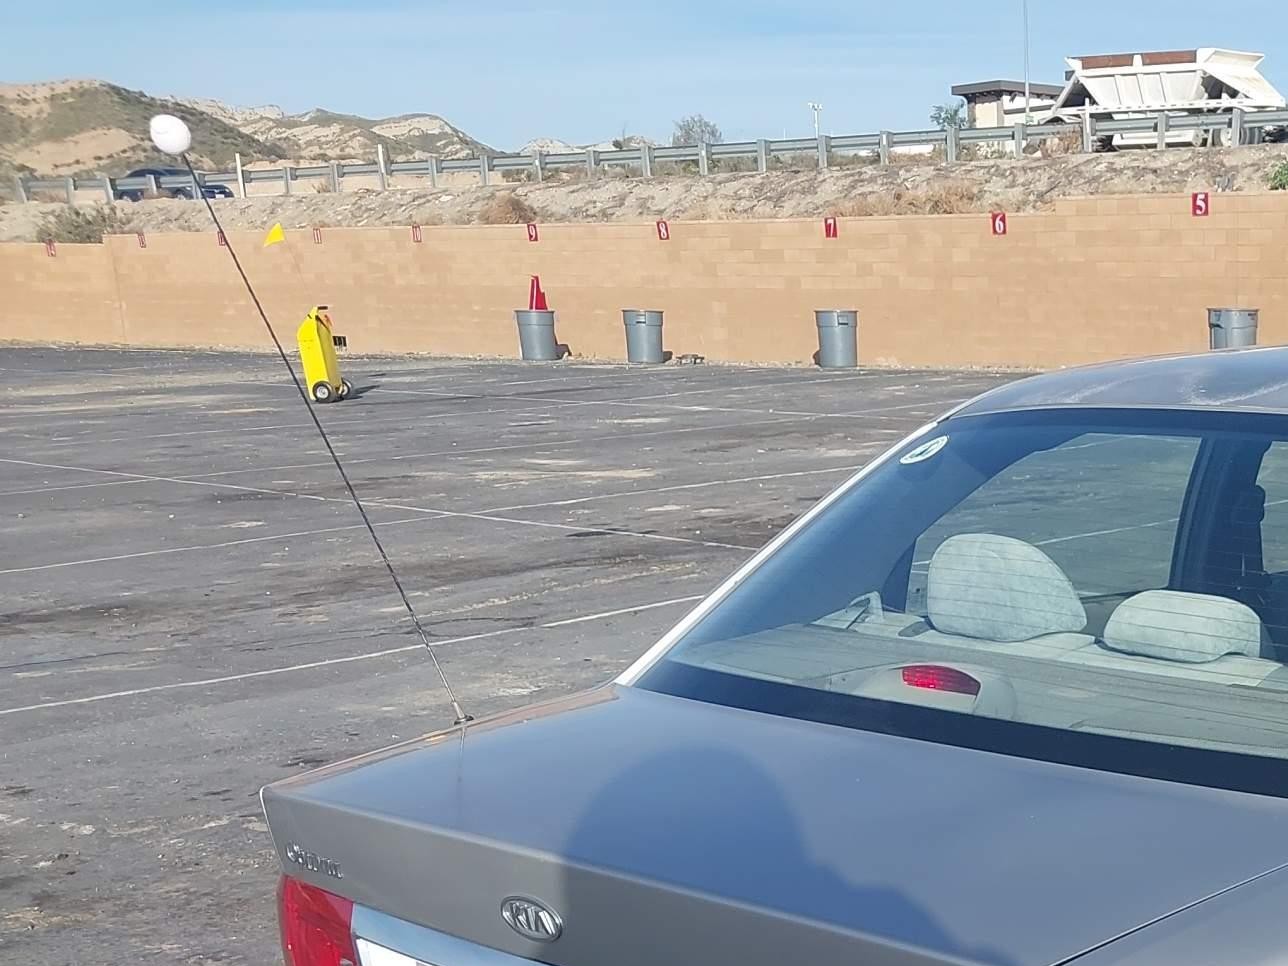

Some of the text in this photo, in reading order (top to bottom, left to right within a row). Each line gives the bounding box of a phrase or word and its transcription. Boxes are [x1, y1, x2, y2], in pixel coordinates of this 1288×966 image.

[1195, 194, 1206, 214] 5
[529, 225, 537, 241] 9
[658, 222, 668, 239] 8
[827, 218, 835, 238] 7
[995, 215, 1005, 234] 6
[502, 900, 557, 937] KIA
